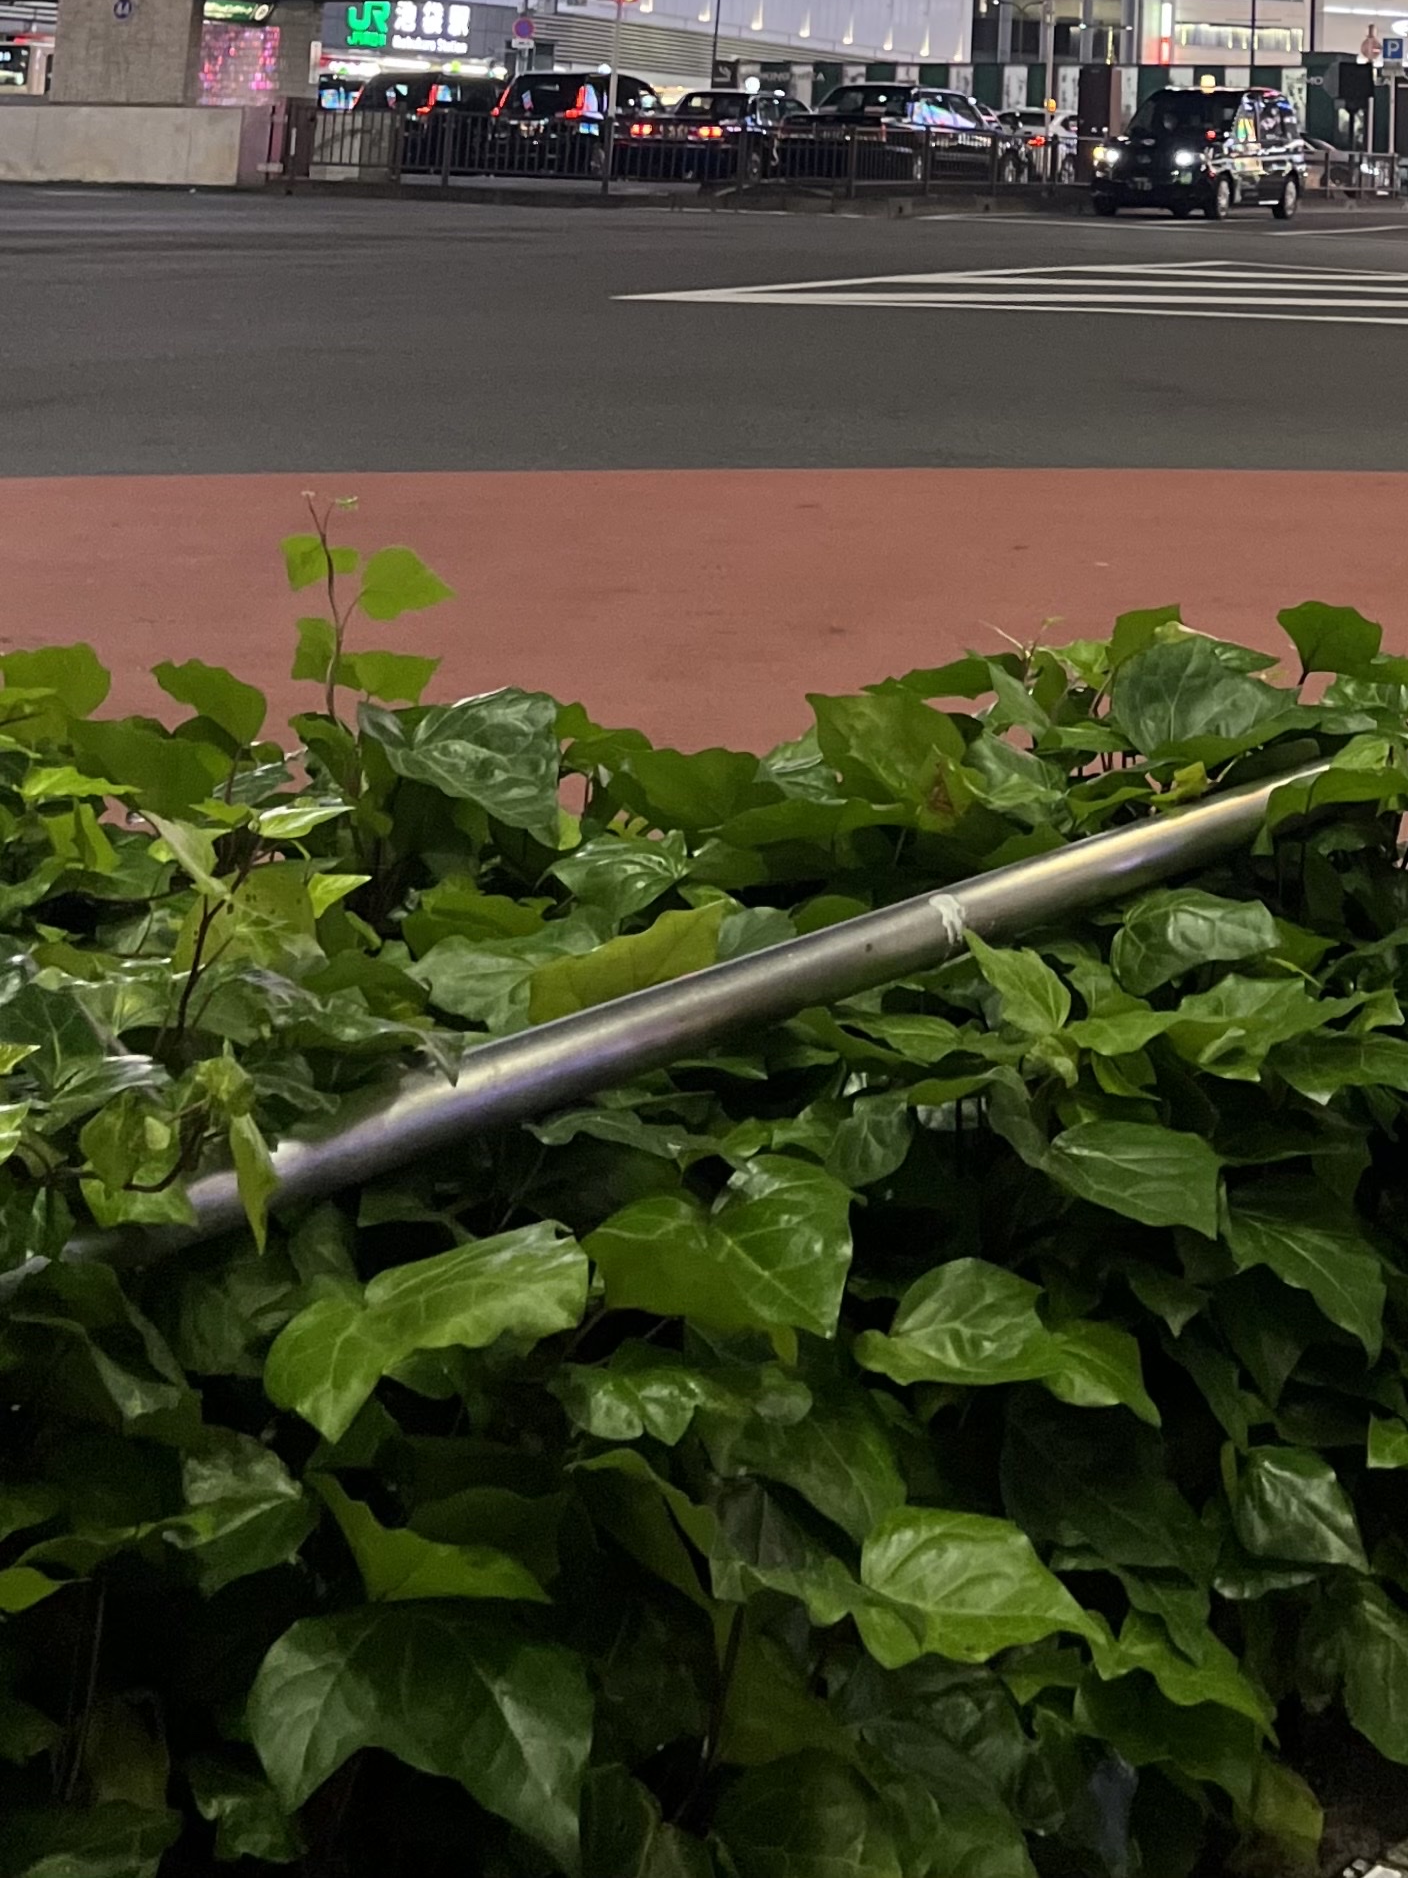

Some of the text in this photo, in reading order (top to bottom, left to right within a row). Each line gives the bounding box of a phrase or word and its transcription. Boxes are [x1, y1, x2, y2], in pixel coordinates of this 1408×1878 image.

[348, 0, 391, 33] JR
[393, 0, 471, 37] 池袋駅
